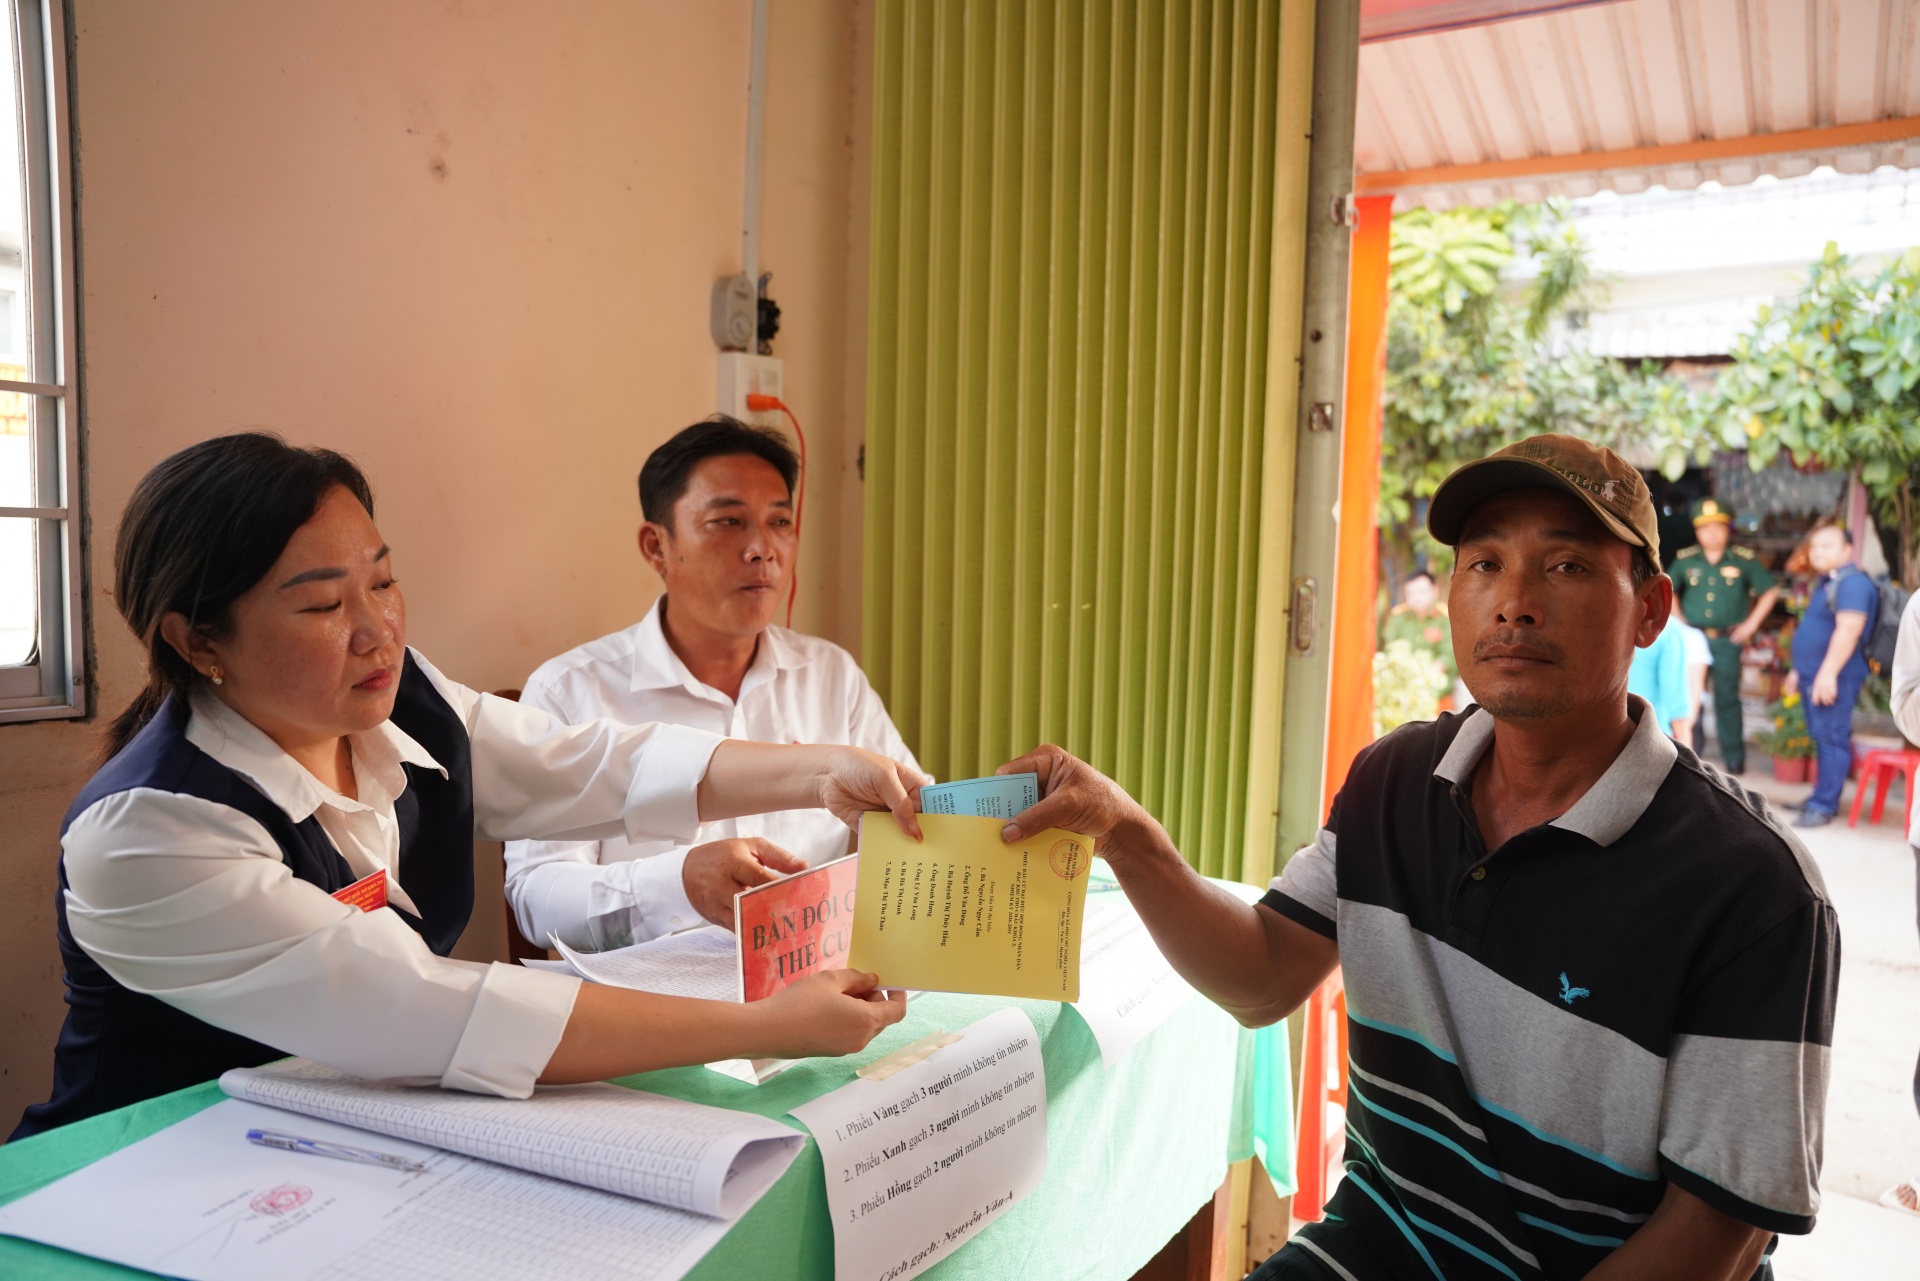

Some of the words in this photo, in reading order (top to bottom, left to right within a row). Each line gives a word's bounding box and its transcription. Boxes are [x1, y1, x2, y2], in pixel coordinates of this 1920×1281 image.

[885, 867, 891, 876] Bà
[900, 868, 907, 877] Bà
[914, 868, 924, 881] Ông
[930, 869, 939, 882] Ông
[948, 870, 954, 879] Bà
[962, 871, 972, 885] Ông
[980, 873, 987, 882] Bà
[897, 887, 905, 898] Thị
[913, 882, 921, 891] Lý
[929, 883, 937, 899] Danh
[945, 880, 953, 900] Huỳnh
[963, 886, 970, 895] Đỗ
[881, 890, 889, 902] Thị
[978, 883, 986, 906] Nguyễn
[802, 892, 838, 931] ĐỐI
[910, 905, 918, 921] Long
[926, 900, 935, 918] Hưng
[944, 901, 952, 912] Thị
[975, 906, 984, 922] Ngọc
[774, 936, 817, 980] THẺ
[835, 1129, 846, 1142] 1.
[846, 1113, 873, 1136] Phiếu
[873, 1104, 900, 1121] Vàng
[900, 1091, 921, 1112] gạch
[920, 1087, 927, 1099] 3
[928, 1074, 953, 1096] người
[953, 1064, 974, 1082] mình
[973, 1056, 997, 1072] không
[996, 1048, 1007, 1060] tín
[1007, 1038, 1029, 1054] nhiệm
[843, 1169, 853, 1182] 2.
[855, 1152, 880, 1176] Phiếu
[882, 1140, 907, 1161] Xanh
[908, 1128, 928, 1150] gạch
[929, 1124, 935, 1136] 3
[936, 1110, 960, 1132] người
[961, 1099, 980, 1118] mình
[980, 1089, 1003, 1108] không
[1003, 1082, 1013, 1094] tín
[1014, 1071, 1035, 1088] nhiệm
[850, 1209, 859, 1223] 3.
[861, 1191, 885, 1216] Phiếu
[887, 1180, 912, 1200] Hồng
[913, 1166, 932, 1188] gạch
[933, 1161, 939, 1173] 2
[940, 1146, 964, 1168] người
[964, 1135, 983, 1154] mình
[984, 1124, 1006, 1142] không
[1006, 1116, 1016, 1130] tín
[1016, 1104, 1037, 1122] nhiệm
[879, 1260, 908, 1281] Cách
[909, 1240, 941, 1269] gạch:
[943, 1210, 982, 1244] Nguyễn
[984, 1197, 1004, 1215] Văn
